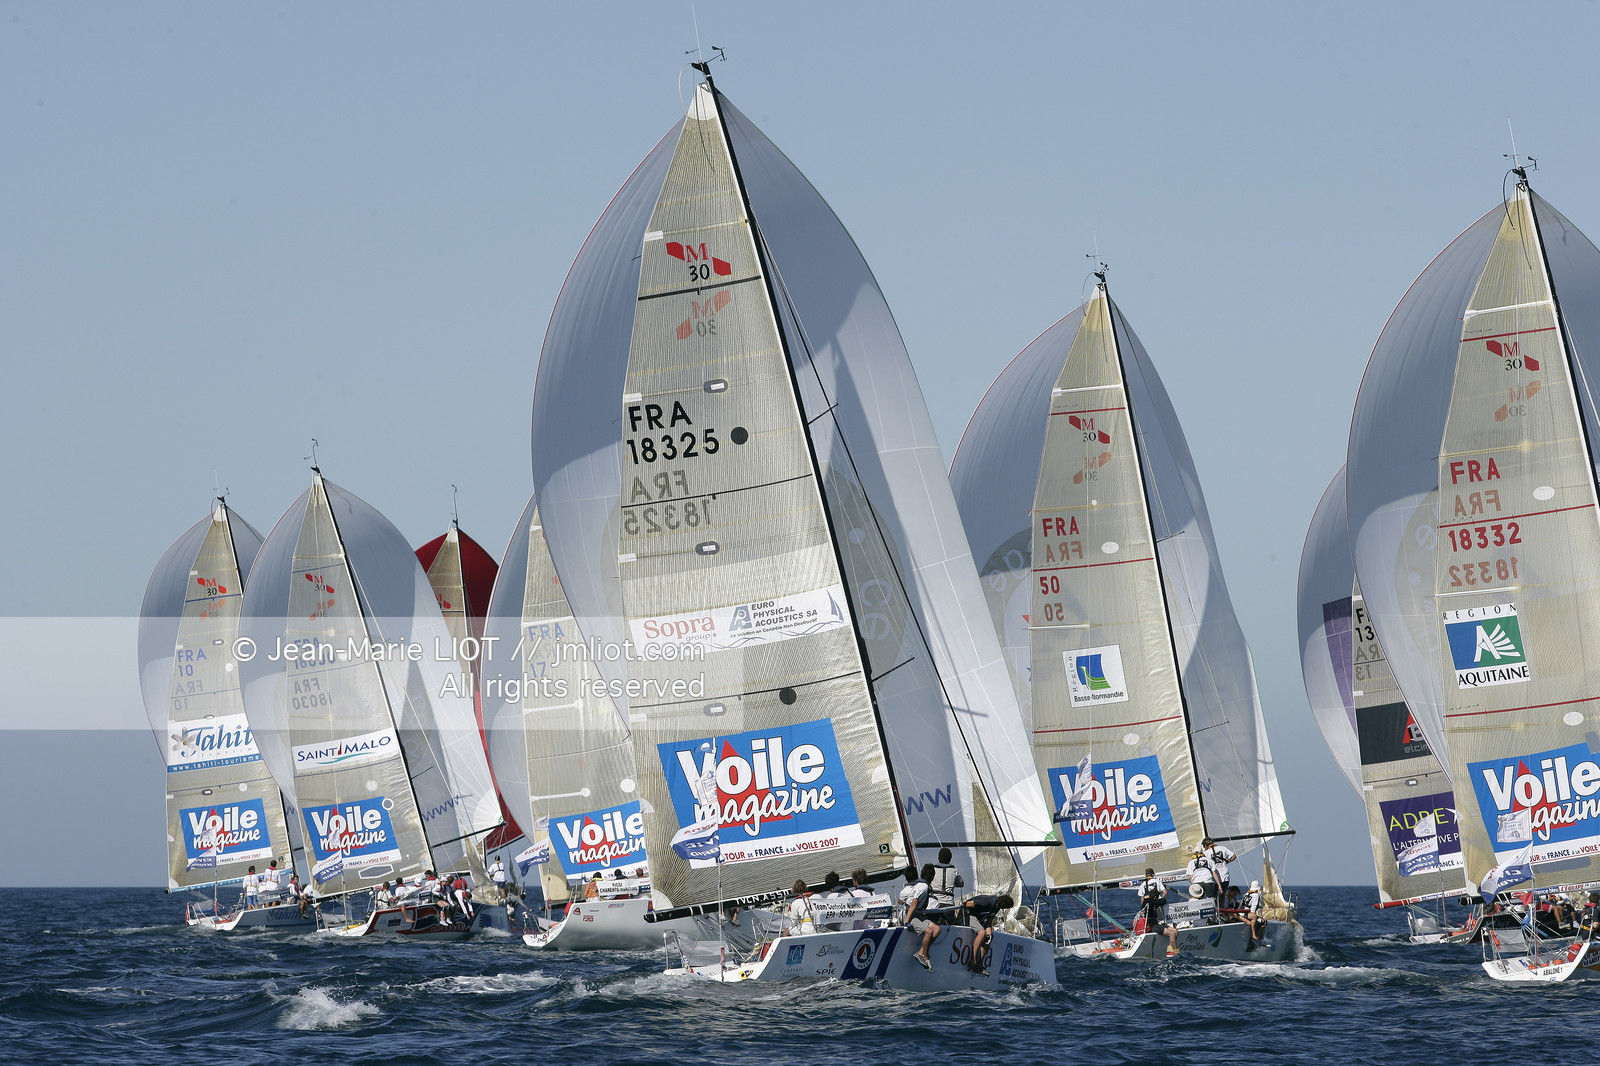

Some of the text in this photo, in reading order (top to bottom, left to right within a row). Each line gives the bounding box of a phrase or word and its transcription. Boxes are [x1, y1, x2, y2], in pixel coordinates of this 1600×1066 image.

[686, 242, 709, 263] M
[688, 263, 710, 282] 30
[1503, 341, 1521, 358] M
[1505, 358, 1523, 371] 30
[628, 400, 693, 433] FRA
[626, 428, 720, 465] 18325
[1082, 432, 1097, 443] 30
[1450, 457, 1502, 485] FRA
[1042, 515, 1080, 538] FRA
[1448, 521, 1522, 553] 18332
[207, 587, 218, 597] 30
[314, 583, 326, 592] 30
[1039, 575, 1061, 596] 50
[751, 600, 775, 611] EURO
[753, 605, 795, 619] PHYSICAL
[1442, 603, 1517, 621] REGION
[643, 616, 717, 641] Sopra
[755, 609, 818, 628] ACOUSTICS SA
[528, 621, 565, 642] FRA
[685, 633, 711, 642] group
[1355, 626, 1375, 643] 13
[177, 648, 207, 664] FRA
[178, 664, 194, 678] 10
[1458, 665, 1530, 686] AQUITAINE
[1073, 690, 1124, 703] Basse-Normandie
[297, 735, 391, 762] SAINT MALO
[675, 735, 826, 801] Voile
[1058, 767, 1153, 808] Voile
[1481, 755, 1600, 812] Voile
[693, 783, 836, 838] magazine
[187, 806, 259, 837] Voile
[310, 806, 383, 837] Voile
[556, 810, 644, 850] Voile
[1070, 801, 1160, 842] magazine
[724, 851, 746, 861] TOUR
[754, 846, 785, 857] FRANCE
[796, 840, 819, 851] VOILE
[819, 837, 839, 848] 2007
[1546, 849, 1571, 859] FRANCE
[1580, 844, 1598, 854] VOILE
